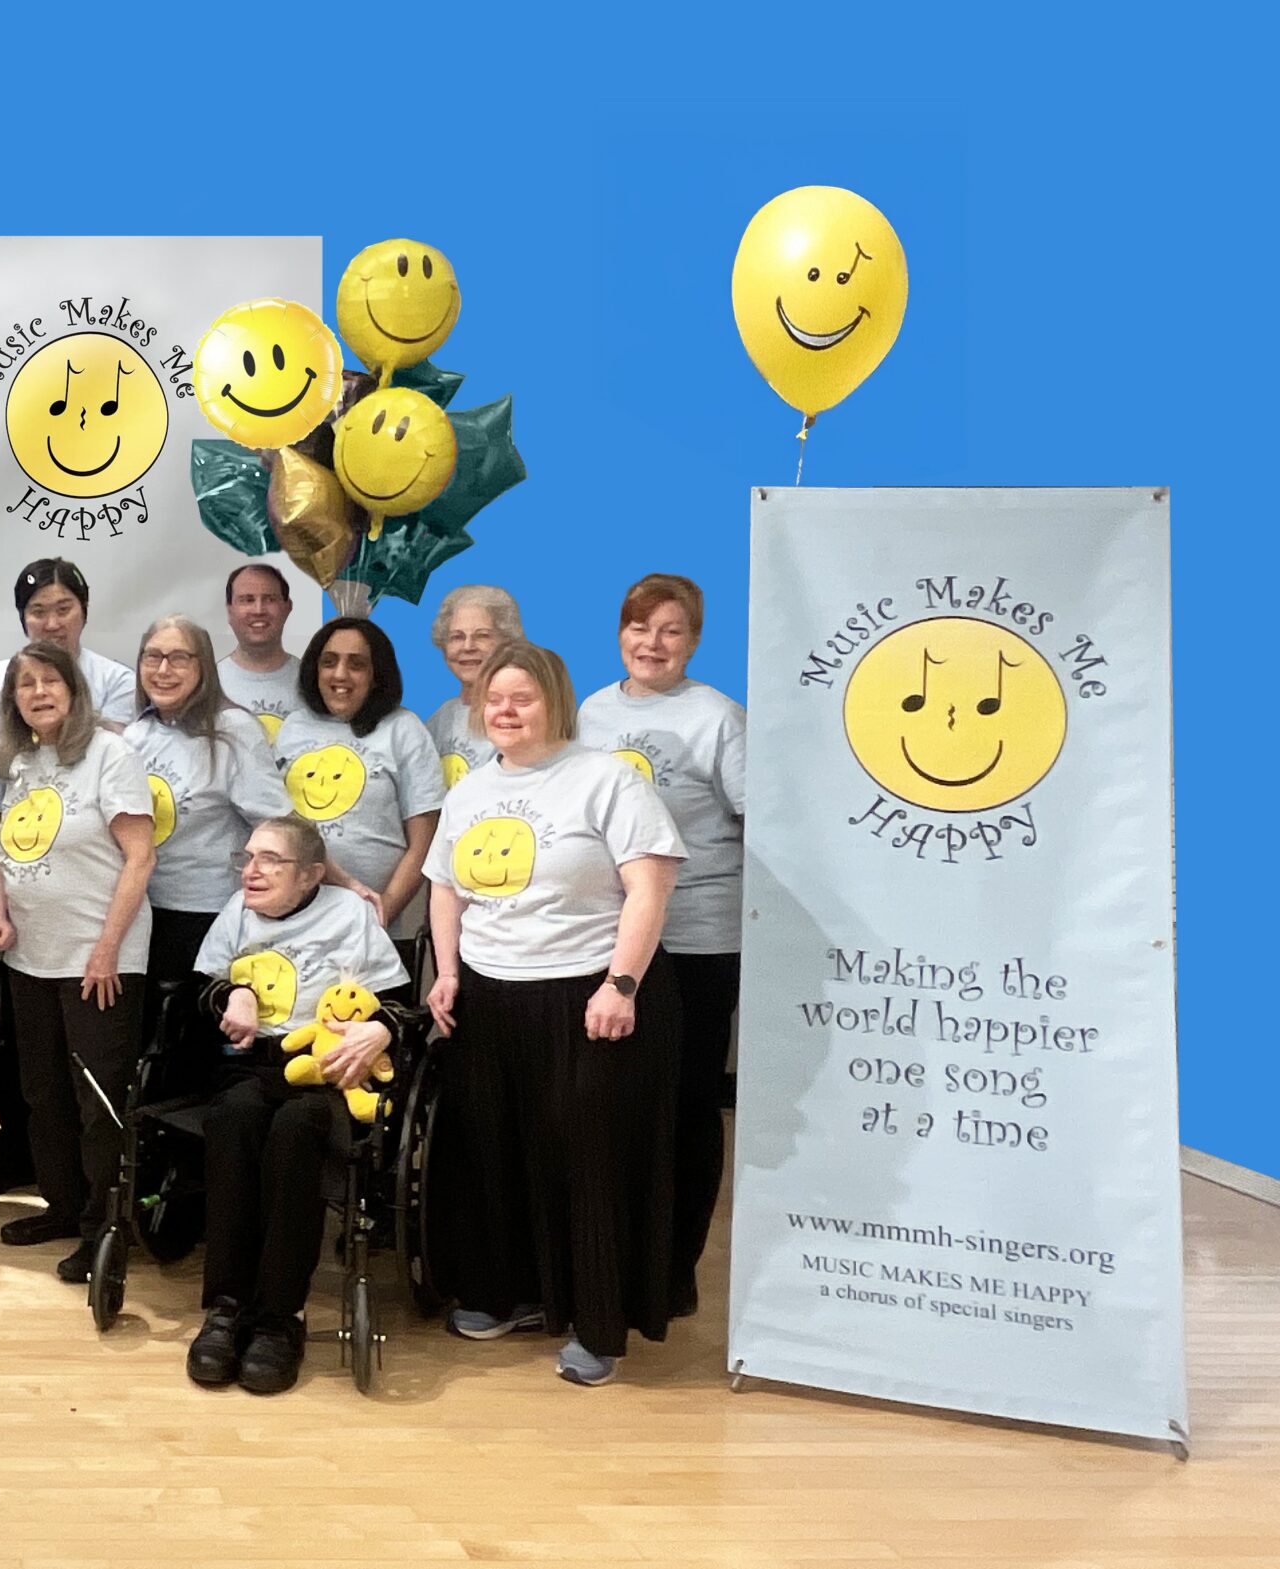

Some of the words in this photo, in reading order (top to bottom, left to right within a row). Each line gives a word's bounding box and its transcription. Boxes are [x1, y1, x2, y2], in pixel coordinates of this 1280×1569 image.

[59, 296, 158, 347] Makes
[160, 345, 195, 398] Me
[799, 595, 898, 690] Music
[916, 575, 1054, 636] Makes
[1058, 633, 1111, 699] Me
[827, 947, 984, 1001] Making
[1000, 957, 1069, 1000] the
[797, 997, 917, 1036] world
[935, 1000, 1099, 1056] happier
[848, 1057, 926, 1088] one
[945, 1063, 1047, 1108] song
[862, 1102, 897, 1135] at
[917, 1113, 934, 1138] a
[952, 1109, 1049, 1151] time
[787, 1212, 1116, 1274] www.mmmh-singers.org
[802, 1254, 874, 1278] MUSIC
[880, 1264, 962, 1290] MAKES
[970, 1276, 1006, 1297] ME
[1013, 1281, 1092, 1307] HAPPY
[820, 1285, 829, 1297] a
[836, 1284, 898, 1306] chorus
[904, 1293, 925, 1310] of
[930, 1298, 996, 1320] special
[1004, 1306, 1073, 1331] singers
